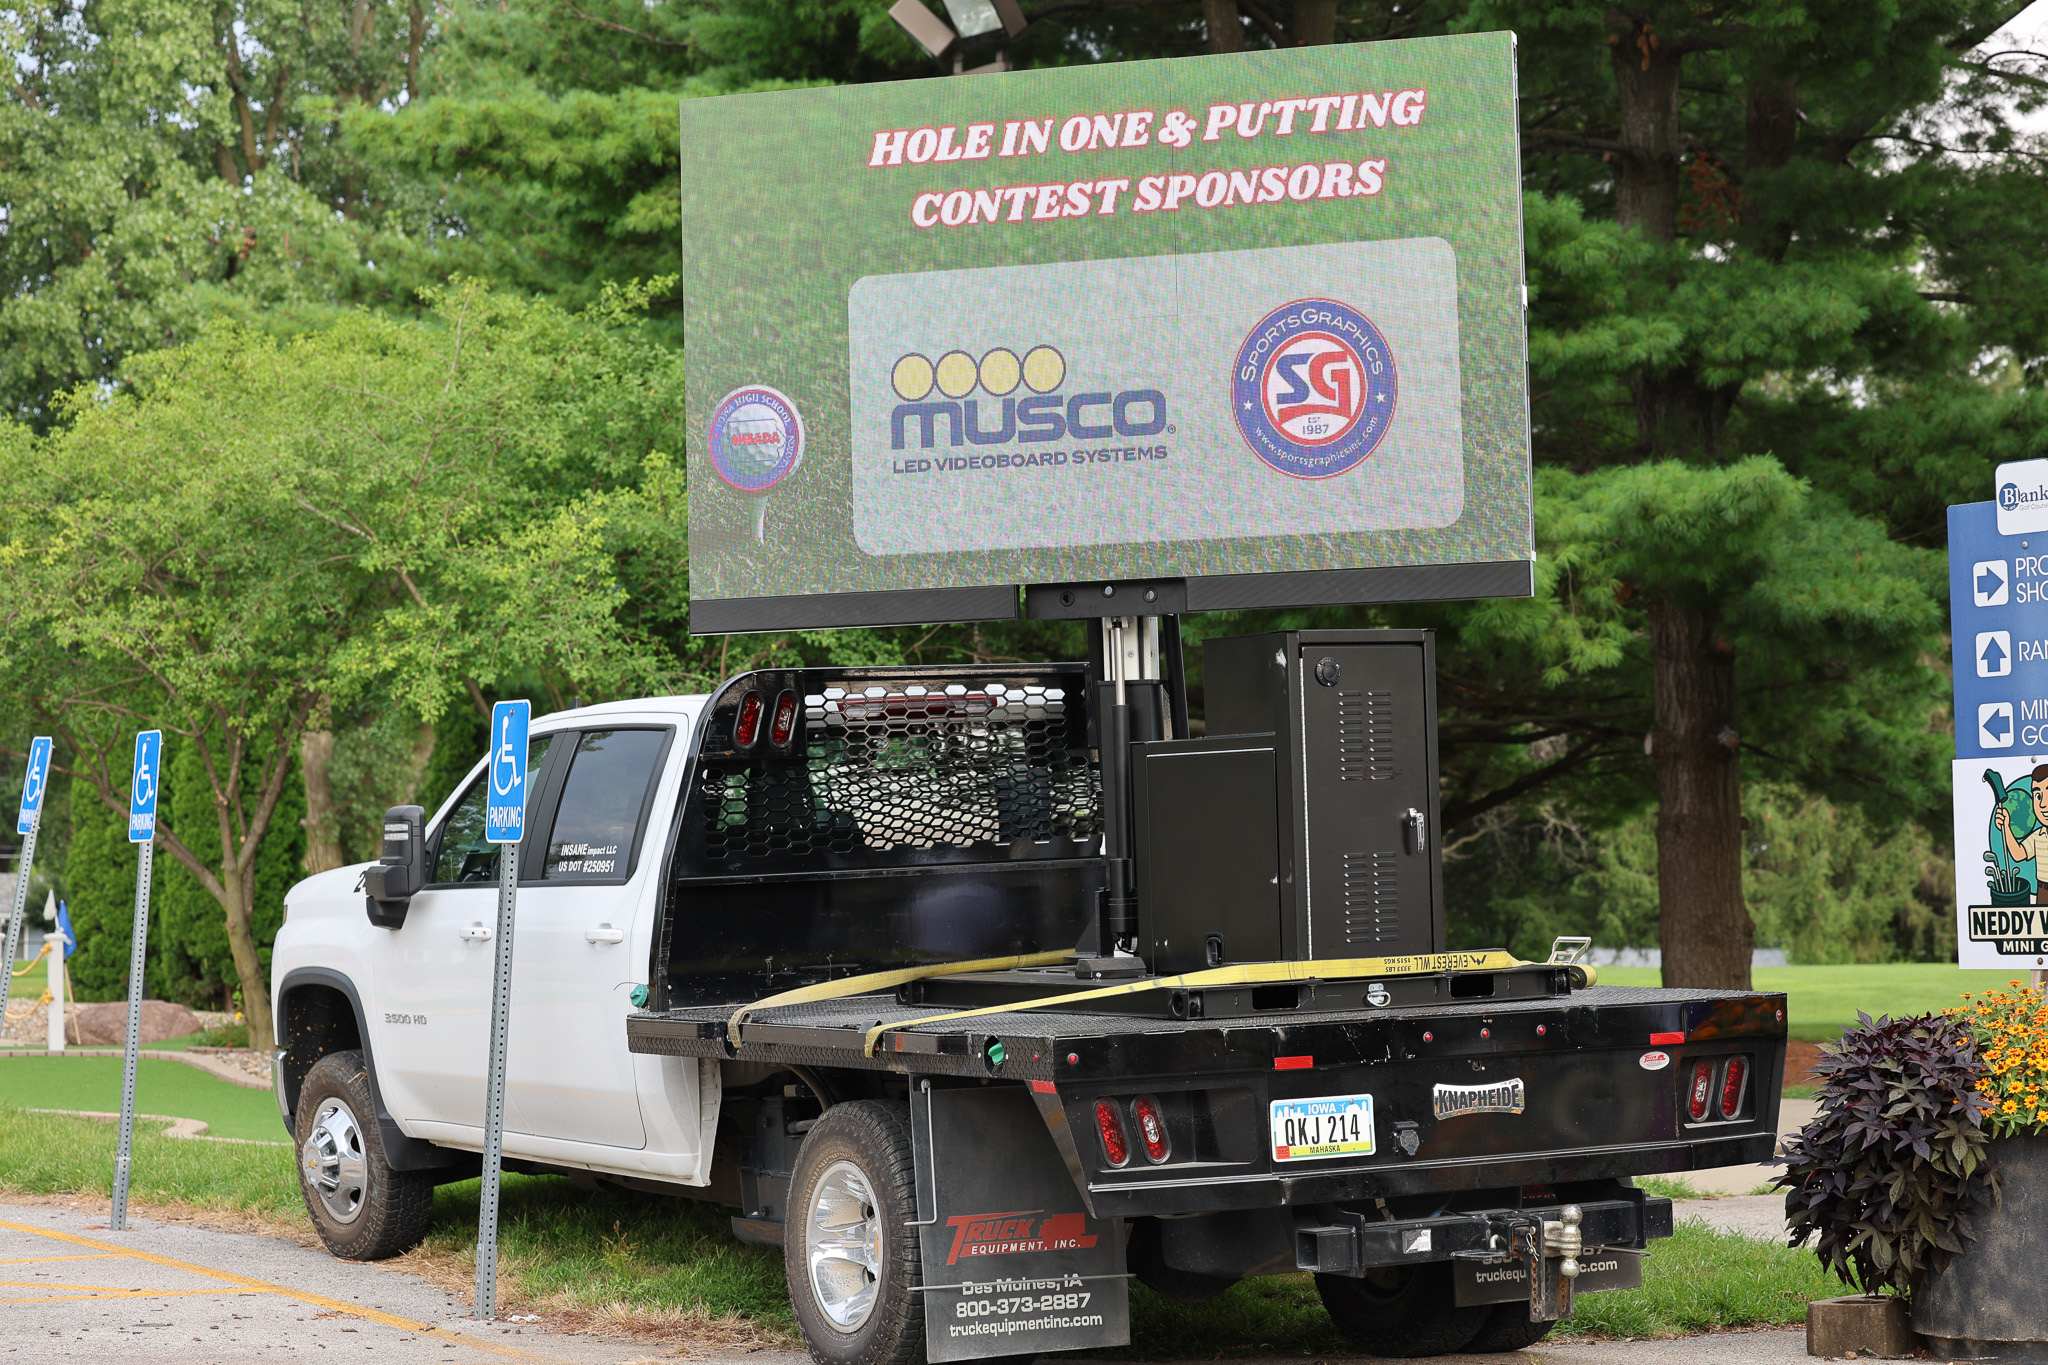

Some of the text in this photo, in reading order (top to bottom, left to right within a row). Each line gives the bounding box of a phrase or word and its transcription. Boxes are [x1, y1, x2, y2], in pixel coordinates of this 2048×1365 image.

[867, 88, 1427, 167] HOLE IN ONE & PUTTING
[911, 158, 1388, 229] CONTEST SPONSORS
[761, 394, 791, 426] SCHOOL
[1302, 424, 1329, 435] 1987
[892, 445, 1168, 474] LED VIDEOBOARD SYSTEMS
[131, 813, 153, 831] PARKING
[489, 806, 521, 828] PARKING
[561, 844, 617, 857] INSANE impact LLC
[558, 860, 615, 873] US DOT #250951
[1973, 911, 2035, 935] NEDDY
[2003, 940, 2034, 952] MINI
[1414, 954, 1468, 971] EVEREST WLL
[413, 1014, 427, 1024] HD
[1308, 1103, 1337, 1115] IOWA
[1438, 1083, 1520, 1114] KNAPHEIDE
[1284, 1113, 1361, 1147] QKJ 214
[1309, 1145, 1341, 1154] MAHASKA
[946, 1209, 1044, 1265] TRUCK
[971, 1239, 1081, 1255] EQUIPMENT, INC.
[962, 1273, 1083, 1296] Des Moines, IA
[956, 1292, 1091, 1318] 800-373-2887
[949, 1314, 1103, 1338] truckequipmentinc.com
